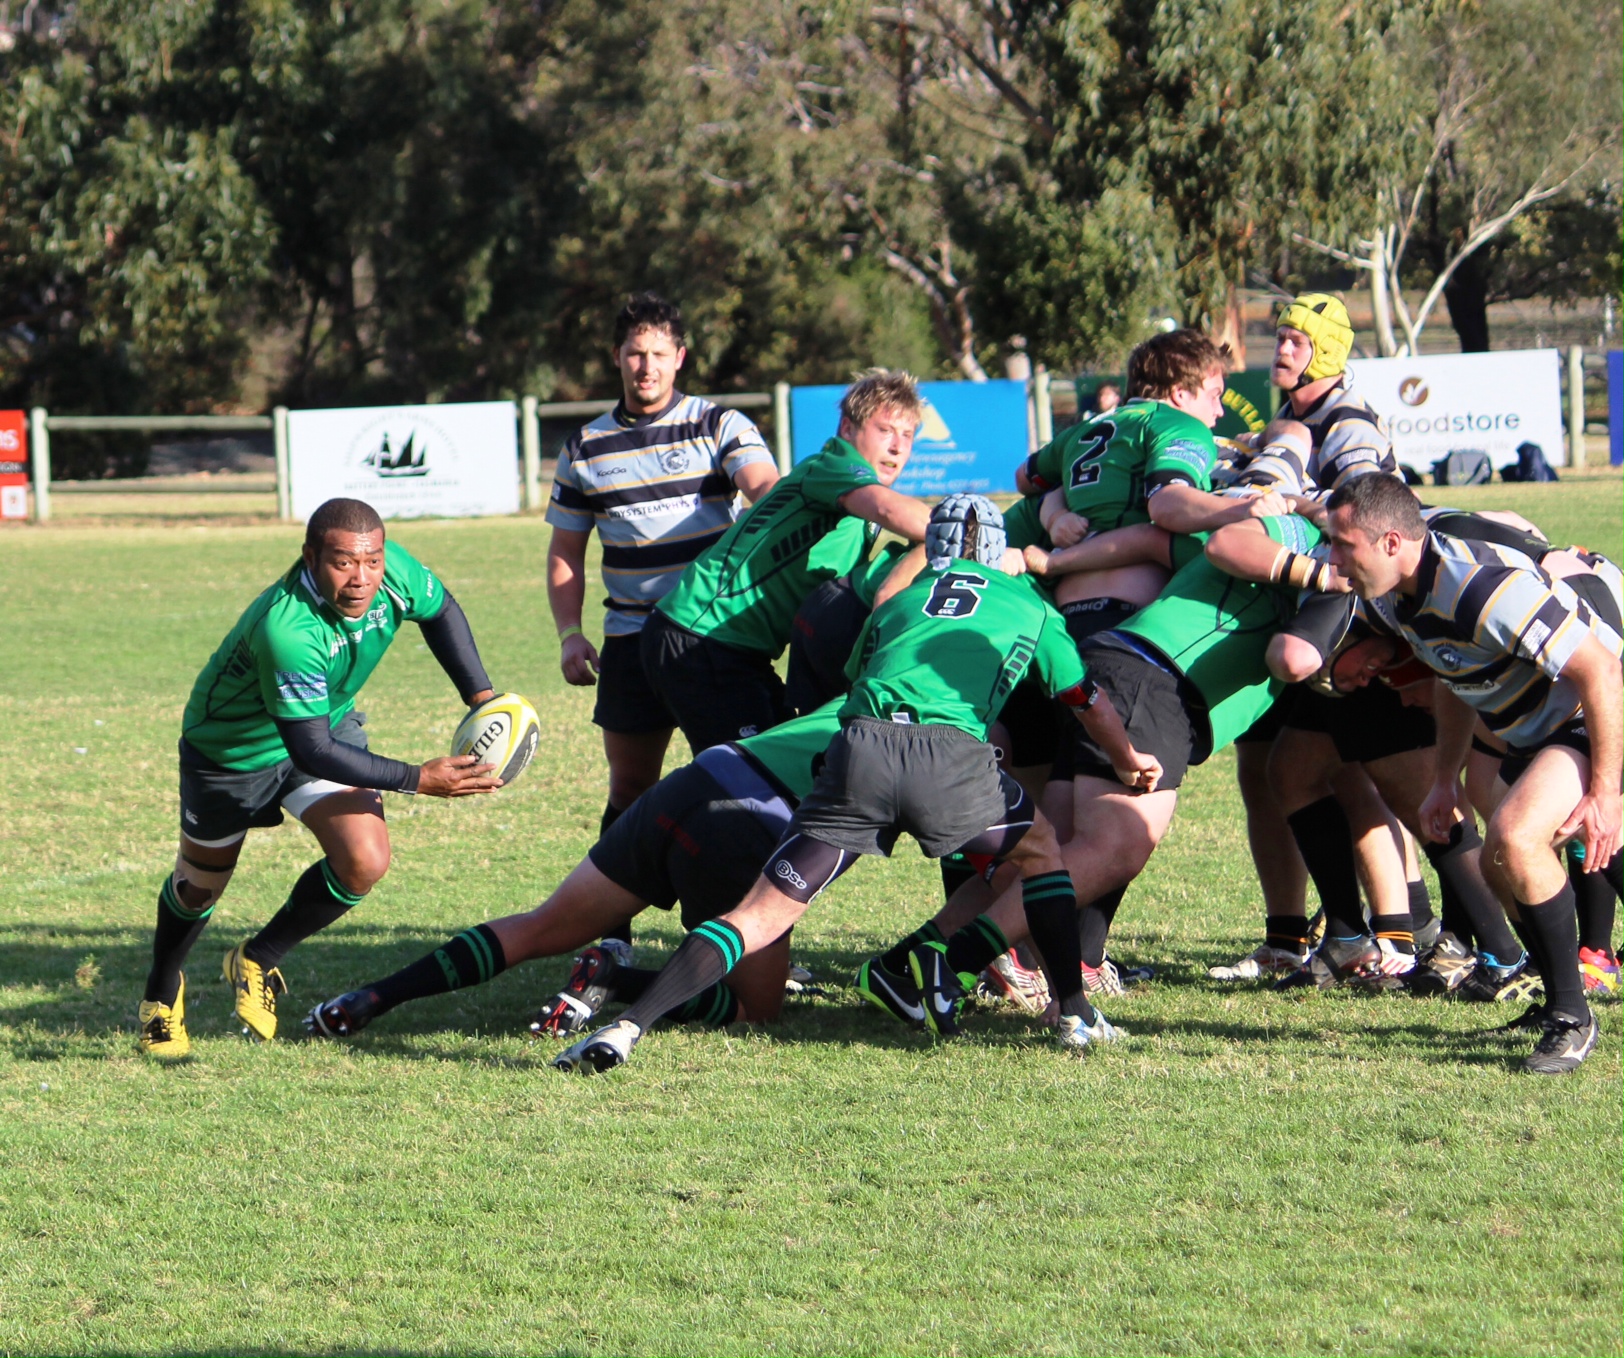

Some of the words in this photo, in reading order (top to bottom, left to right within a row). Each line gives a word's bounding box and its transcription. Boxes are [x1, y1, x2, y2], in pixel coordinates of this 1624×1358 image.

[1388, 411, 1520, 436] foodstore
[597, 467, 627, 478] KooGa
[1069, 420, 1117, 490] 2
[921, 571, 989, 620] 6
